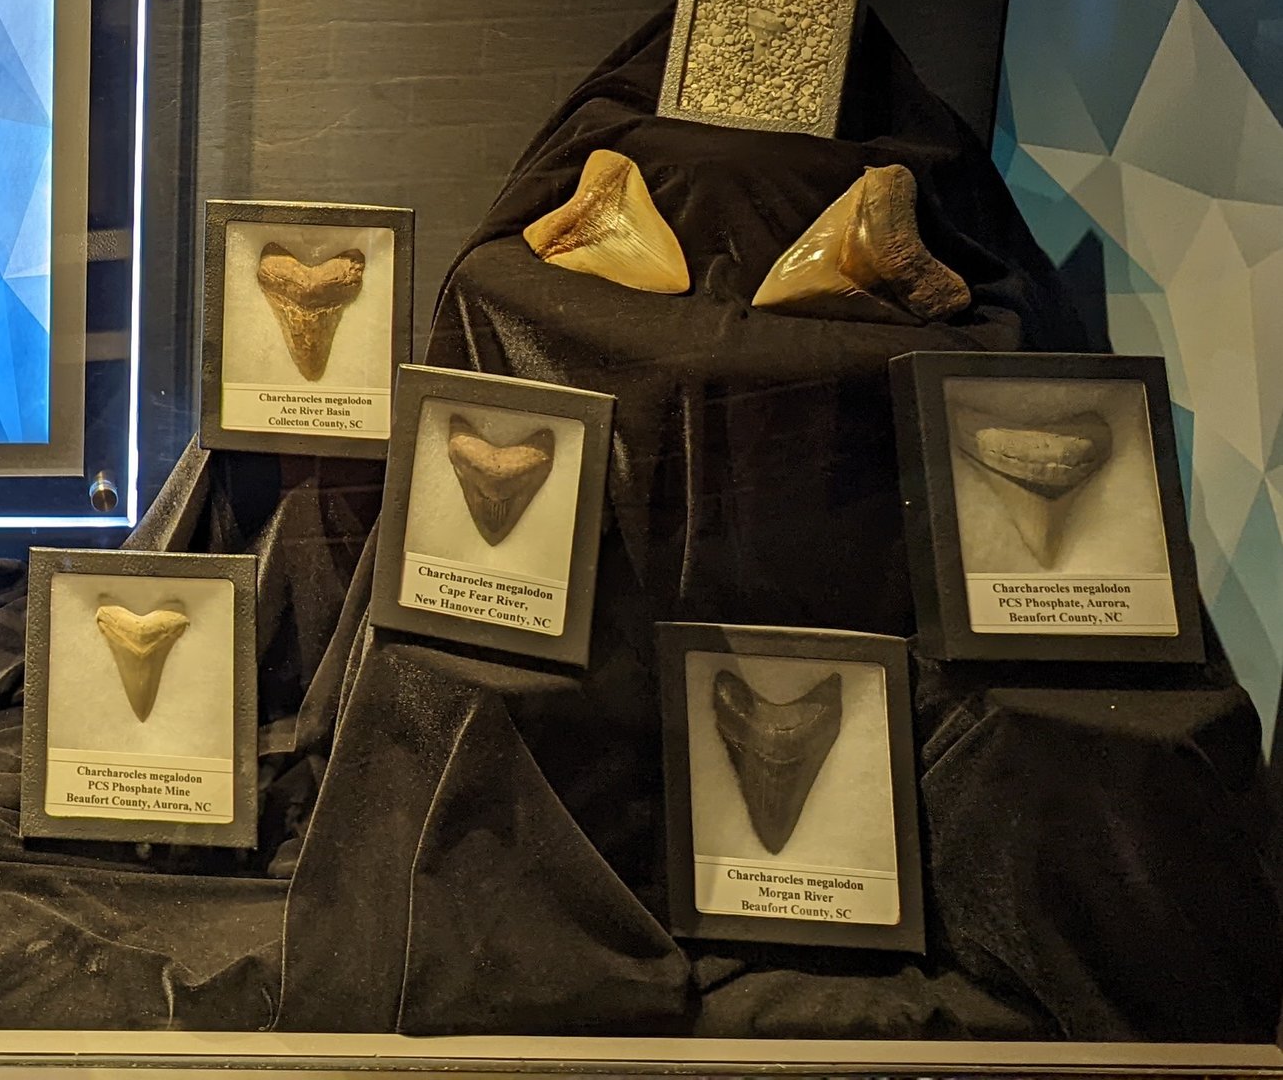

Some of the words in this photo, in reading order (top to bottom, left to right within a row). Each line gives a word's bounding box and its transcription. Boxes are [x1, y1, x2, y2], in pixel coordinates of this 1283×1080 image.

[258, 392, 322, 403] Charcharocles
[324, 396, 372, 406] megalodon
[280, 406, 297, 414] Ace
[299, 407, 324, 415] River
[326, 407, 350, 416] Basin
[311, 418, 347, 430] County,
[349, 419, 363, 428] SC
[418, 565, 493, 588] Charcharocles
[495, 582, 553, 600] megalodon
[992, 583, 1070, 593] Charcharocles
[1072, 583, 1131, 595] megalodon
[438, 584, 466, 598] Cape
[468, 589, 493, 602] Fear
[496, 594, 528, 610] River,
[998, 597, 1022, 607] PCS
[1024, 597, 1084, 610] Phosphate,
[1086, 598, 1129, 608] Aurora,
[414, 593, 437, 606] New
[440, 598, 485, 615] Hanover
[487, 607, 529, 626] County,
[532, 616, 551, 628] NC
[1008, 612, 1056, 622] Beaufort
[1058, 612, 1102, 626] County,
[1104, 612, 1122, 622] NC
[76, 765, 147, 779] Charcharocles
[149, 772, 202, 783] megalodon
[88, 780, 109, 790] PCS
[111, 781, 162, 795] Phosphate
[165, 785, 190, 796] Mine
[66, 792, 109, 805] Beaufort
[111, 795, 150, 811] County,
[152, 799, 192, 811] Aurora,
[194, 801, 211, 812] NC
[727, 869, 804, 885] Charcharocles
[806, 878, 864, 890] megalodon
[758, 887, 800, 901] Morgan
[803, 890, 834, 902] River
[741, 900, 787, 914] Beaufort
[790, 904, 833, 919] County,
[835, 908, 851, 919] SC
